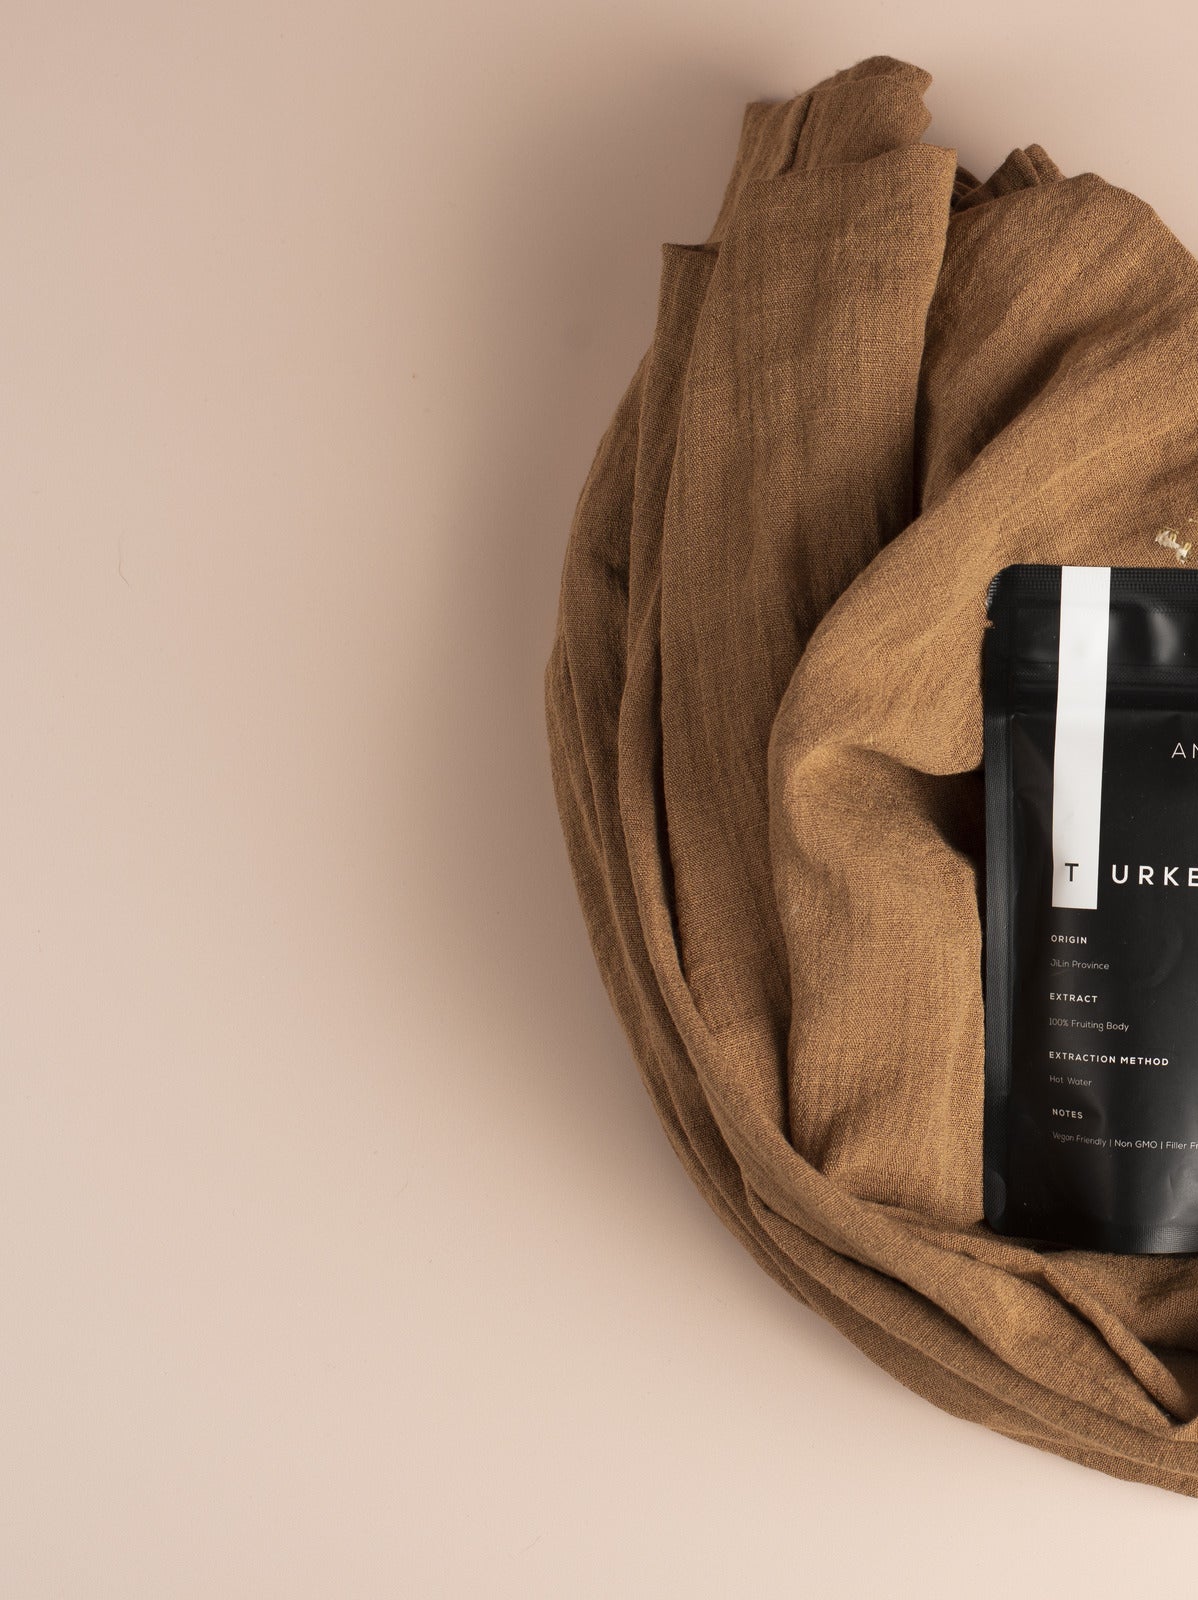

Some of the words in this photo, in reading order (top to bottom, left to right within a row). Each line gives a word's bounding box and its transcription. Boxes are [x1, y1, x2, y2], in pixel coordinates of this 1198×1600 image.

[1050, 934, 1088, 944] ORIGIN
[1050, 959, 1070, 968] JiLin
[1072, 960, 1110, 970] Province
[1049, 992, 1098, 1003] EXTRACT
[1049, 1017, 1069, 1027] 100%
[1071, 1019, 1104, 1032] Fruiting
[1106, 1021, 1129, 1032] Body
[1049, 1051, 1116, 1064] EXTRACTION
[1120, 1056, 1169, 1066] METHOD
[1049, 1075, 1064, 1084] Hot
[1067, 1077, 1092, 1087] Water
[1052, 1108, 1083, 1119] NOTES
[1052, 1132, 1075, 1143] Vegan
[1076, 1134, 1107, 1147] Friendly
[1114, 1139, 1133, 1148] Non
[1135, 1140, 1158, 1149] GMO
[1166, 1141, 1187, 1149] Filler
